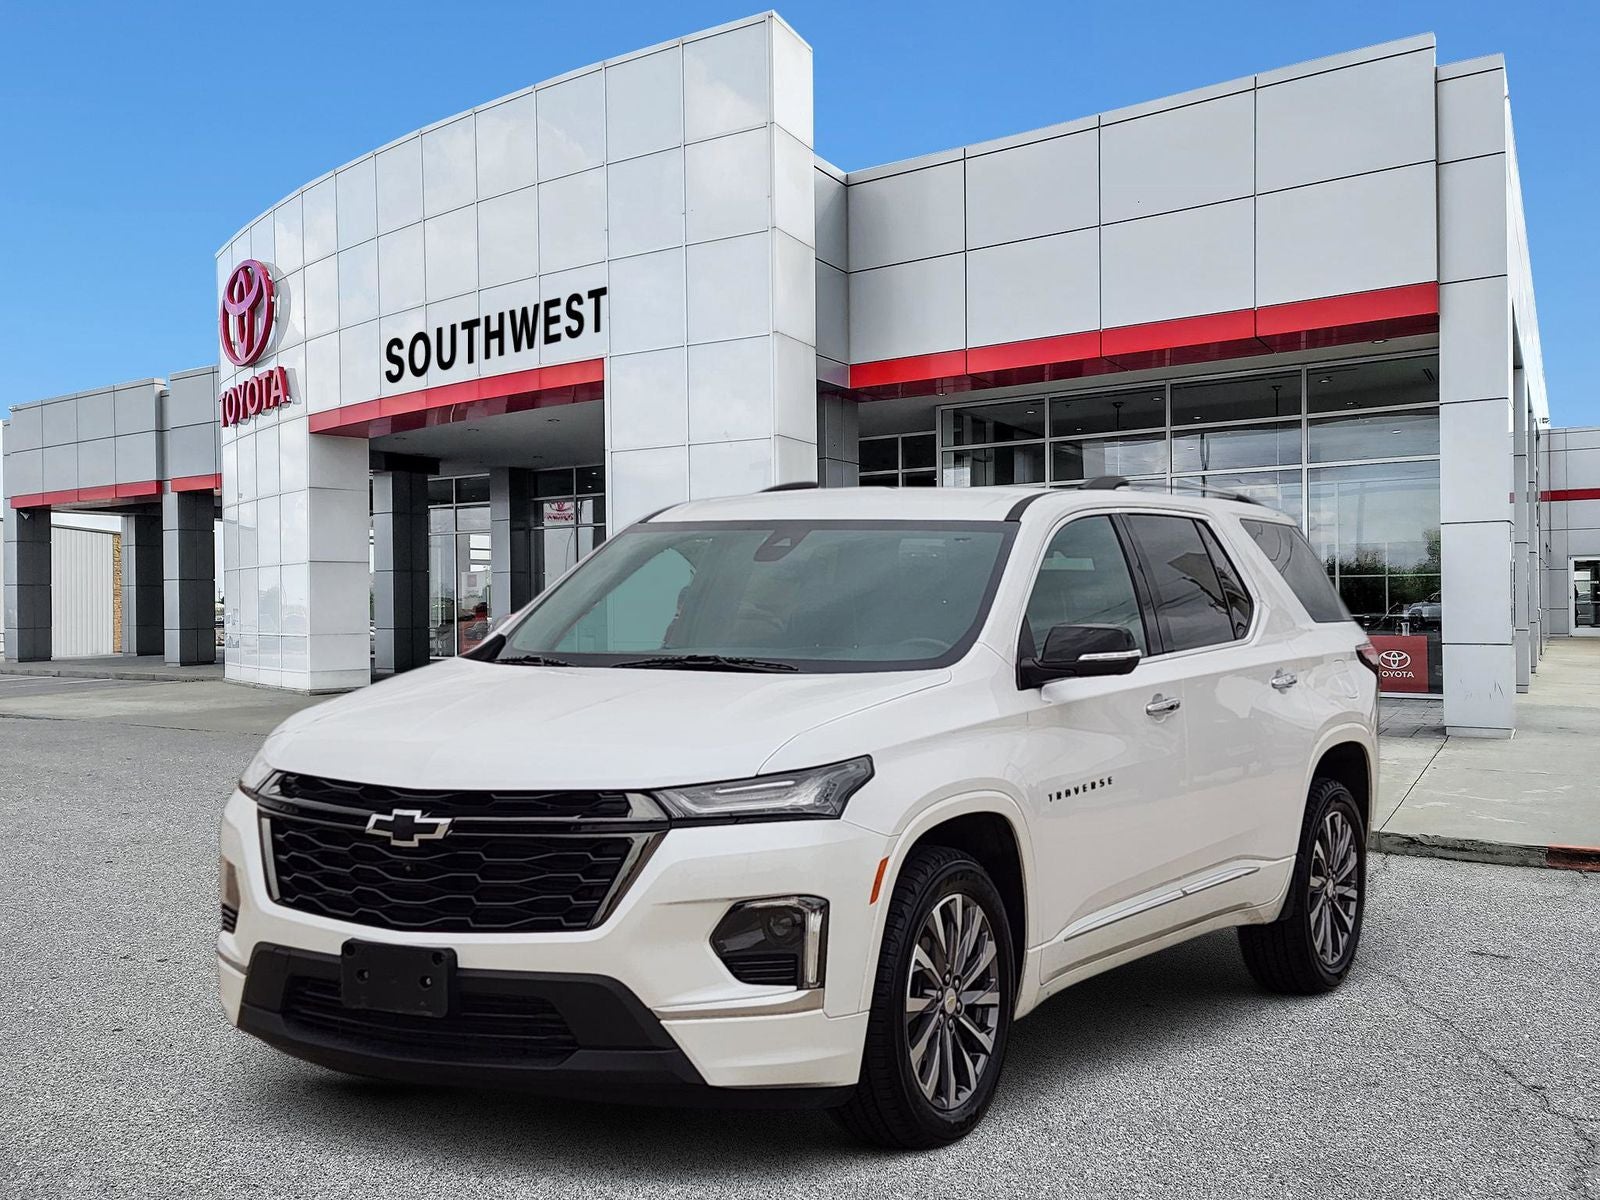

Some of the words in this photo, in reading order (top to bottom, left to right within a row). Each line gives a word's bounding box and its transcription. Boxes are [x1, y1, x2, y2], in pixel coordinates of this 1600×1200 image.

[385, 286, 607, 384] SOUTHWEST
[219, 366, 291, 427] TOYOTA
[1048, 776, 1113, 802] TRAVERSE
